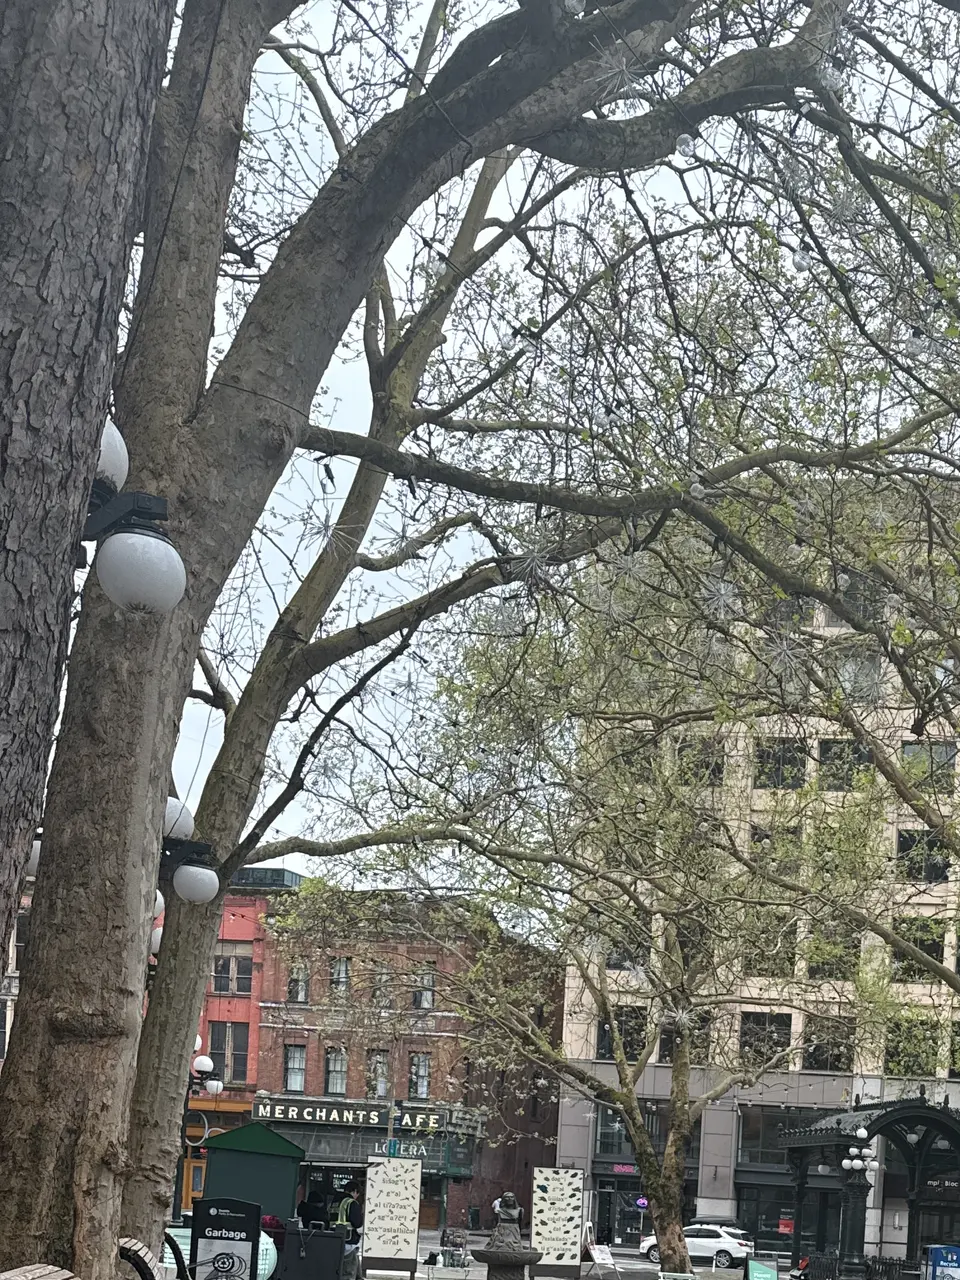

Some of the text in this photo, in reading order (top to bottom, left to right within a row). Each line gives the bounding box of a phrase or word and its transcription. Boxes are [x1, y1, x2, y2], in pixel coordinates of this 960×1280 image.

[258, 1104, 440, 1128] MERCHANTS AFE
[205, 1227, 247, 1240] Garbage
[939, 1260, 959, 1268] Recycle
